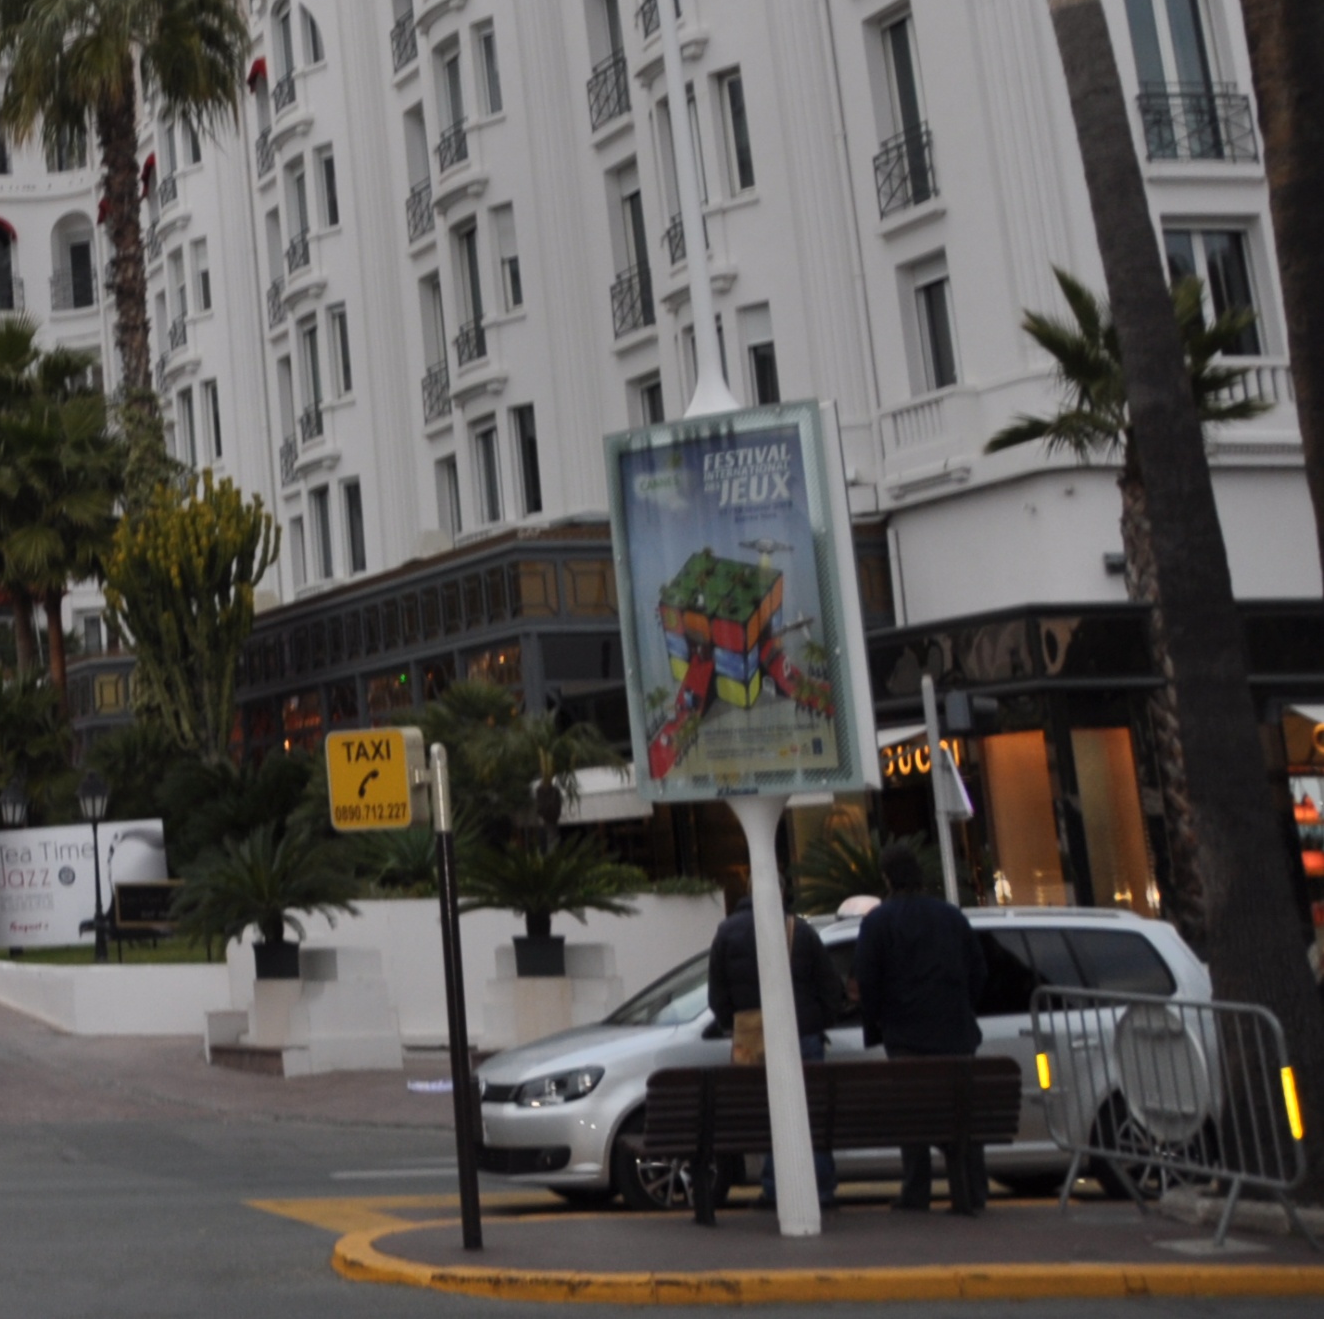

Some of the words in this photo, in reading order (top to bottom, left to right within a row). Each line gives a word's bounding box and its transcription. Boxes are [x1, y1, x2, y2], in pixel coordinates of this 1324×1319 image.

[703, 442, 791, 472] FESTIVAL
[703, 461, 789, 481] INTERNATIONAL
[718, 470, 791, 508] JEUX
[341, 739, 392, 763] TAXI
[335, 802, 407, 823] 0890.712.227
[38, 840, 95, 863] Time
